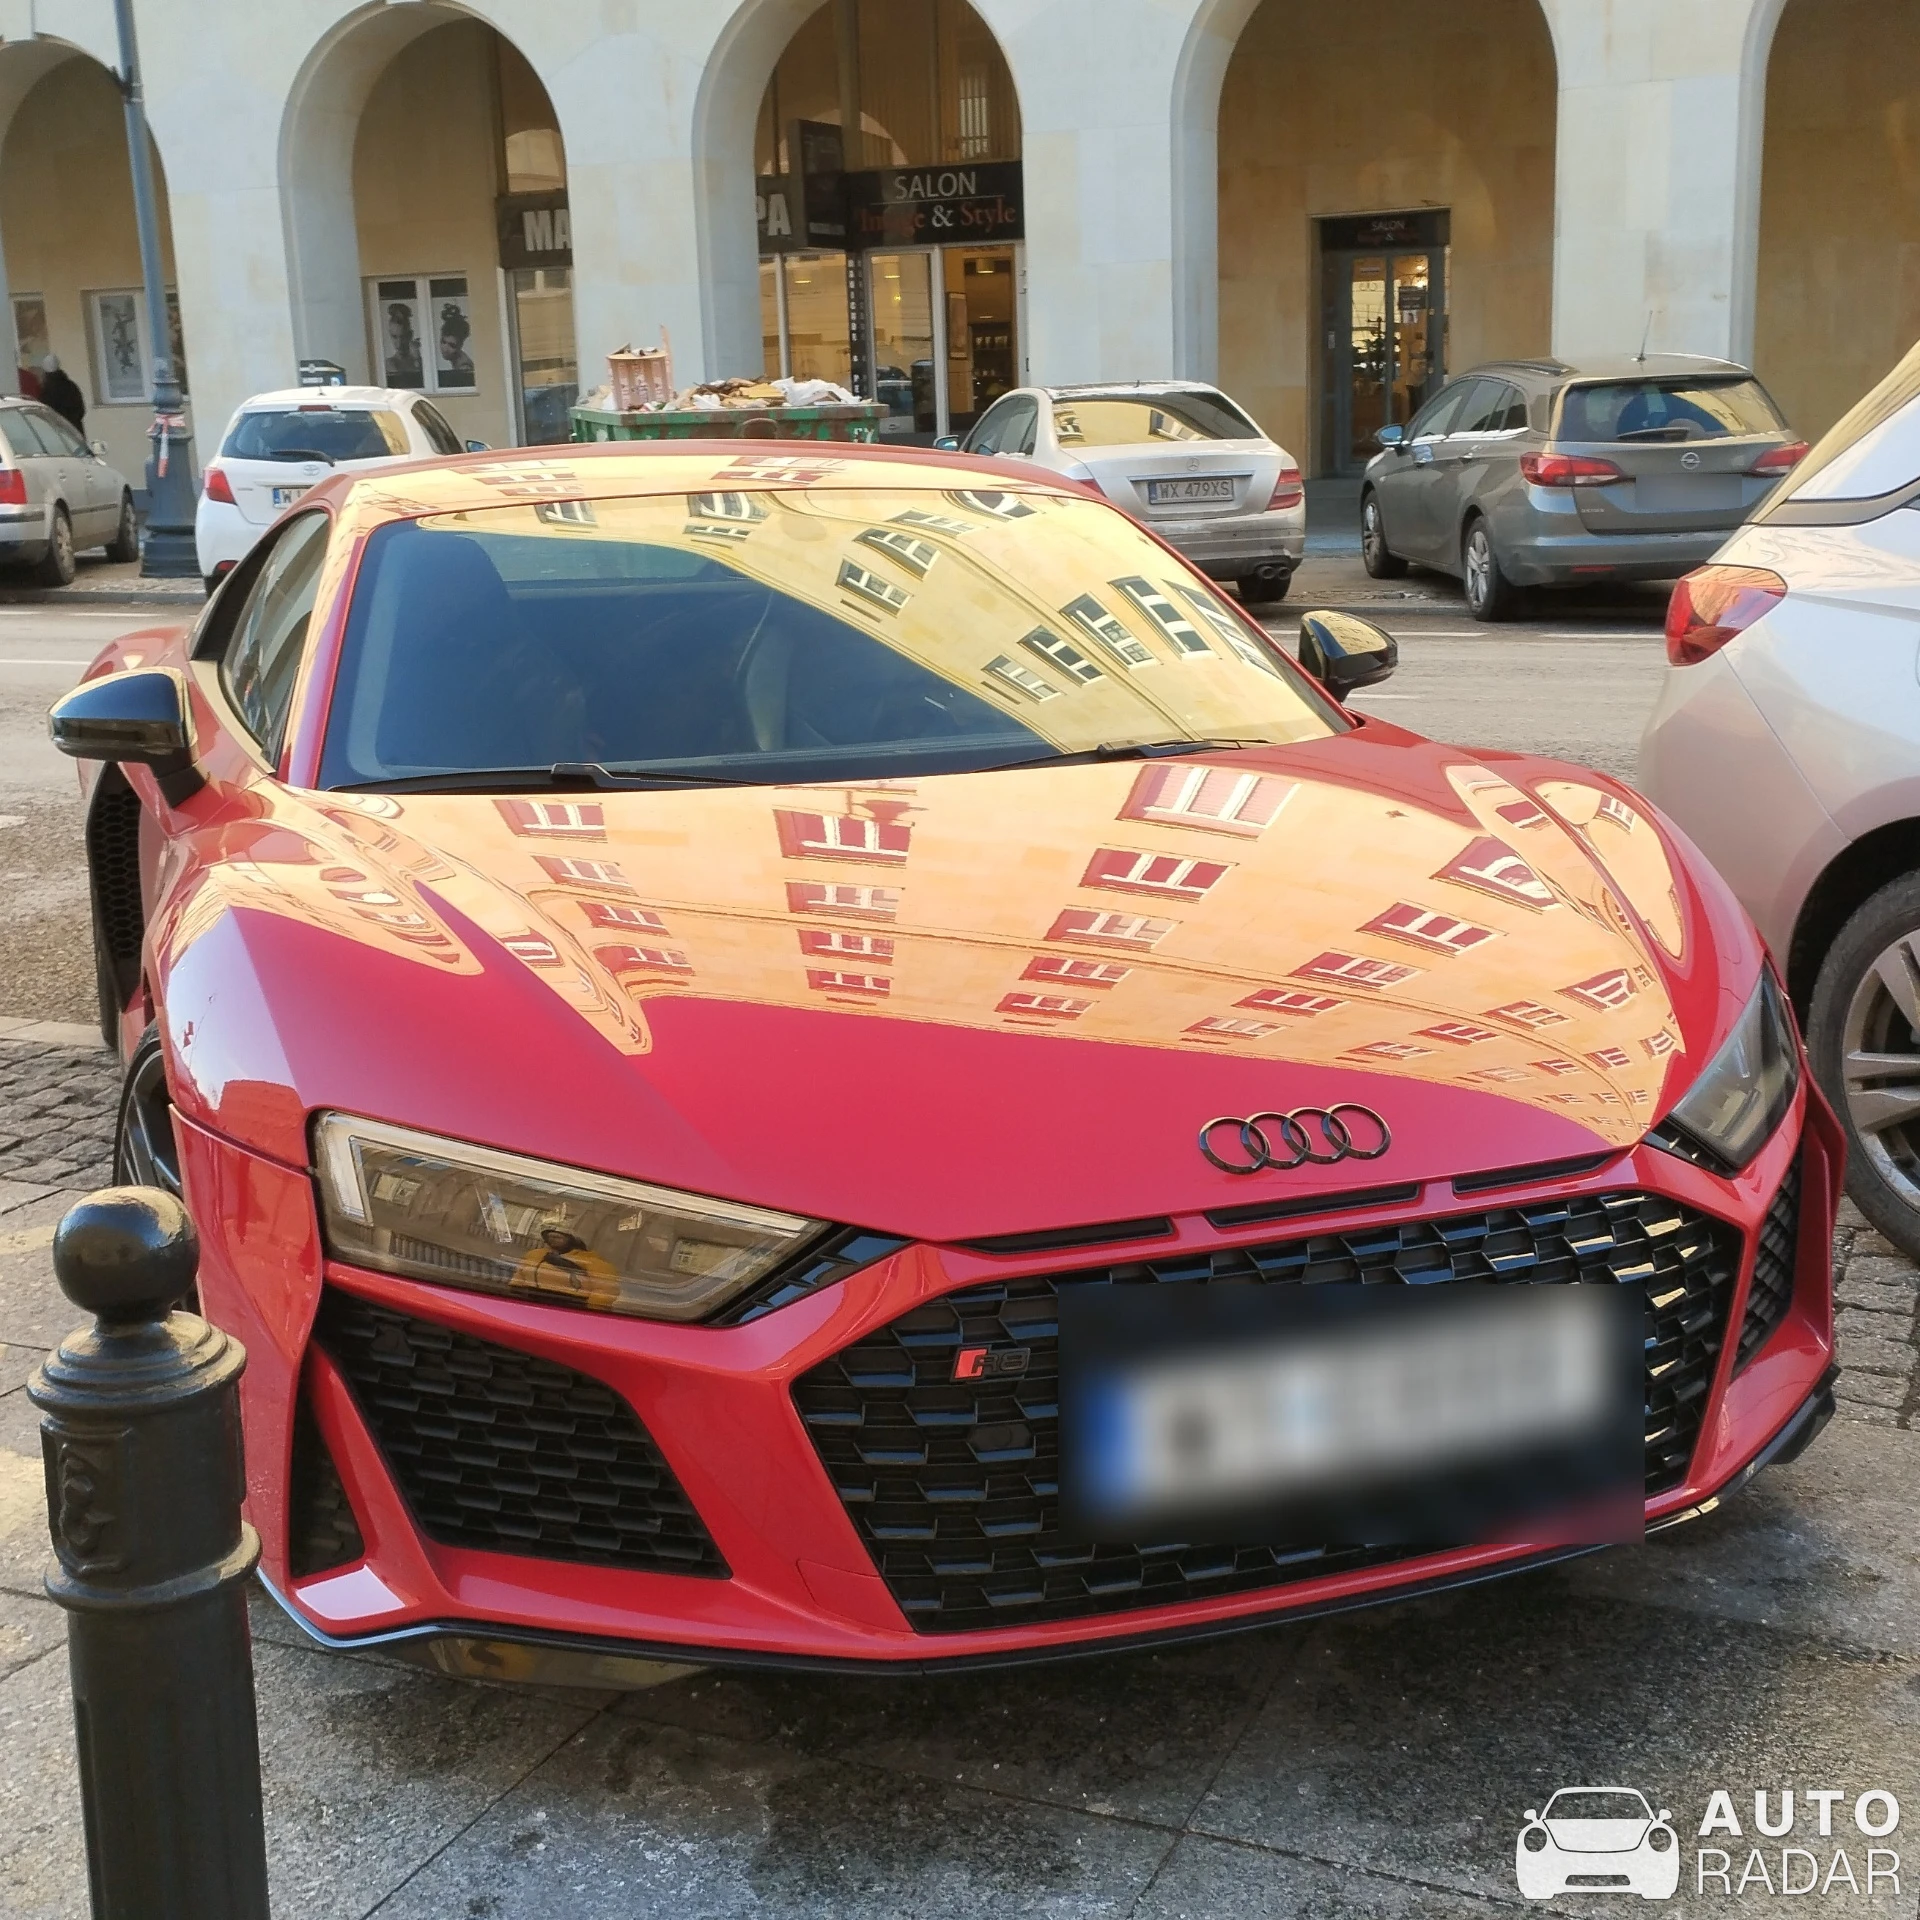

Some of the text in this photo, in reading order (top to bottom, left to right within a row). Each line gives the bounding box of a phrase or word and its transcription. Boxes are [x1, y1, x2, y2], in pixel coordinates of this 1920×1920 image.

[894, 171, 976, 199] SALON
[931, 204, 954, 228] &
[960, 196, 1016, 233] Style
